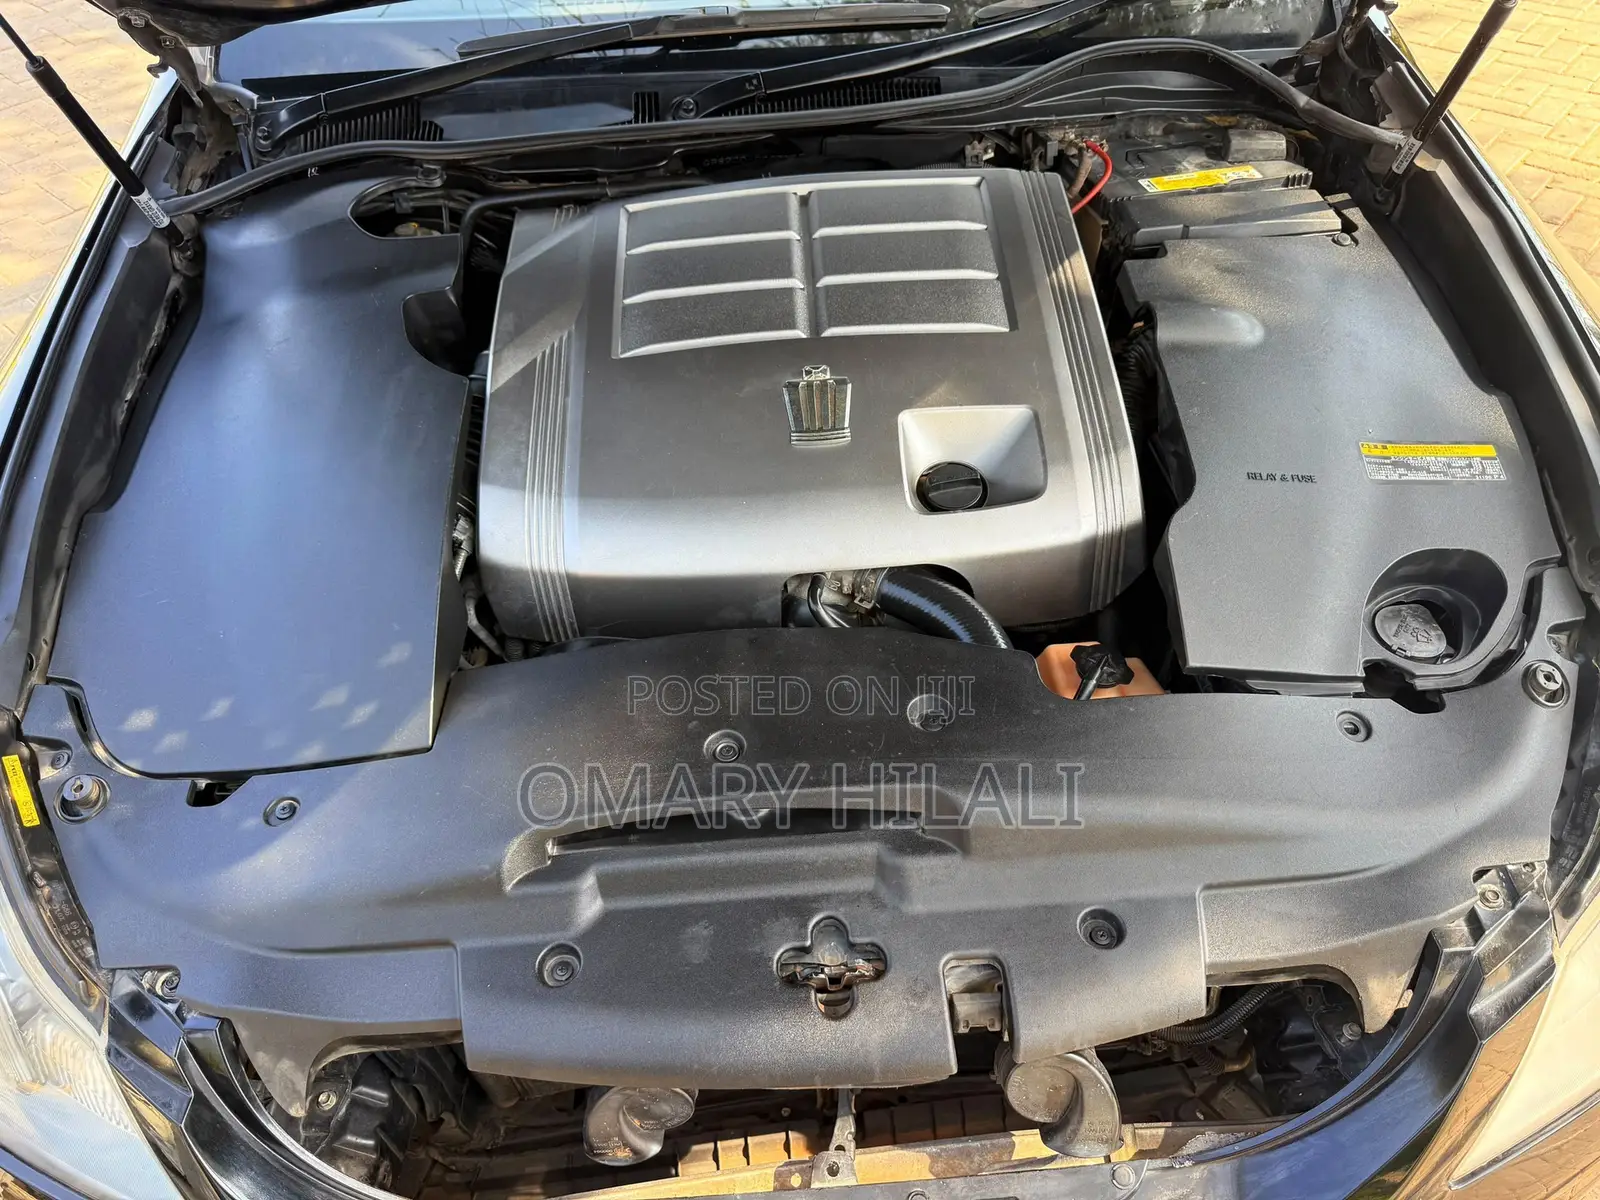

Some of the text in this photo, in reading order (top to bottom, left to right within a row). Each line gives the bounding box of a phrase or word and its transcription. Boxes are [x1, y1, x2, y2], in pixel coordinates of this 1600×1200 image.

[1246, 471, 1317, 484] RELAY & FUSE
